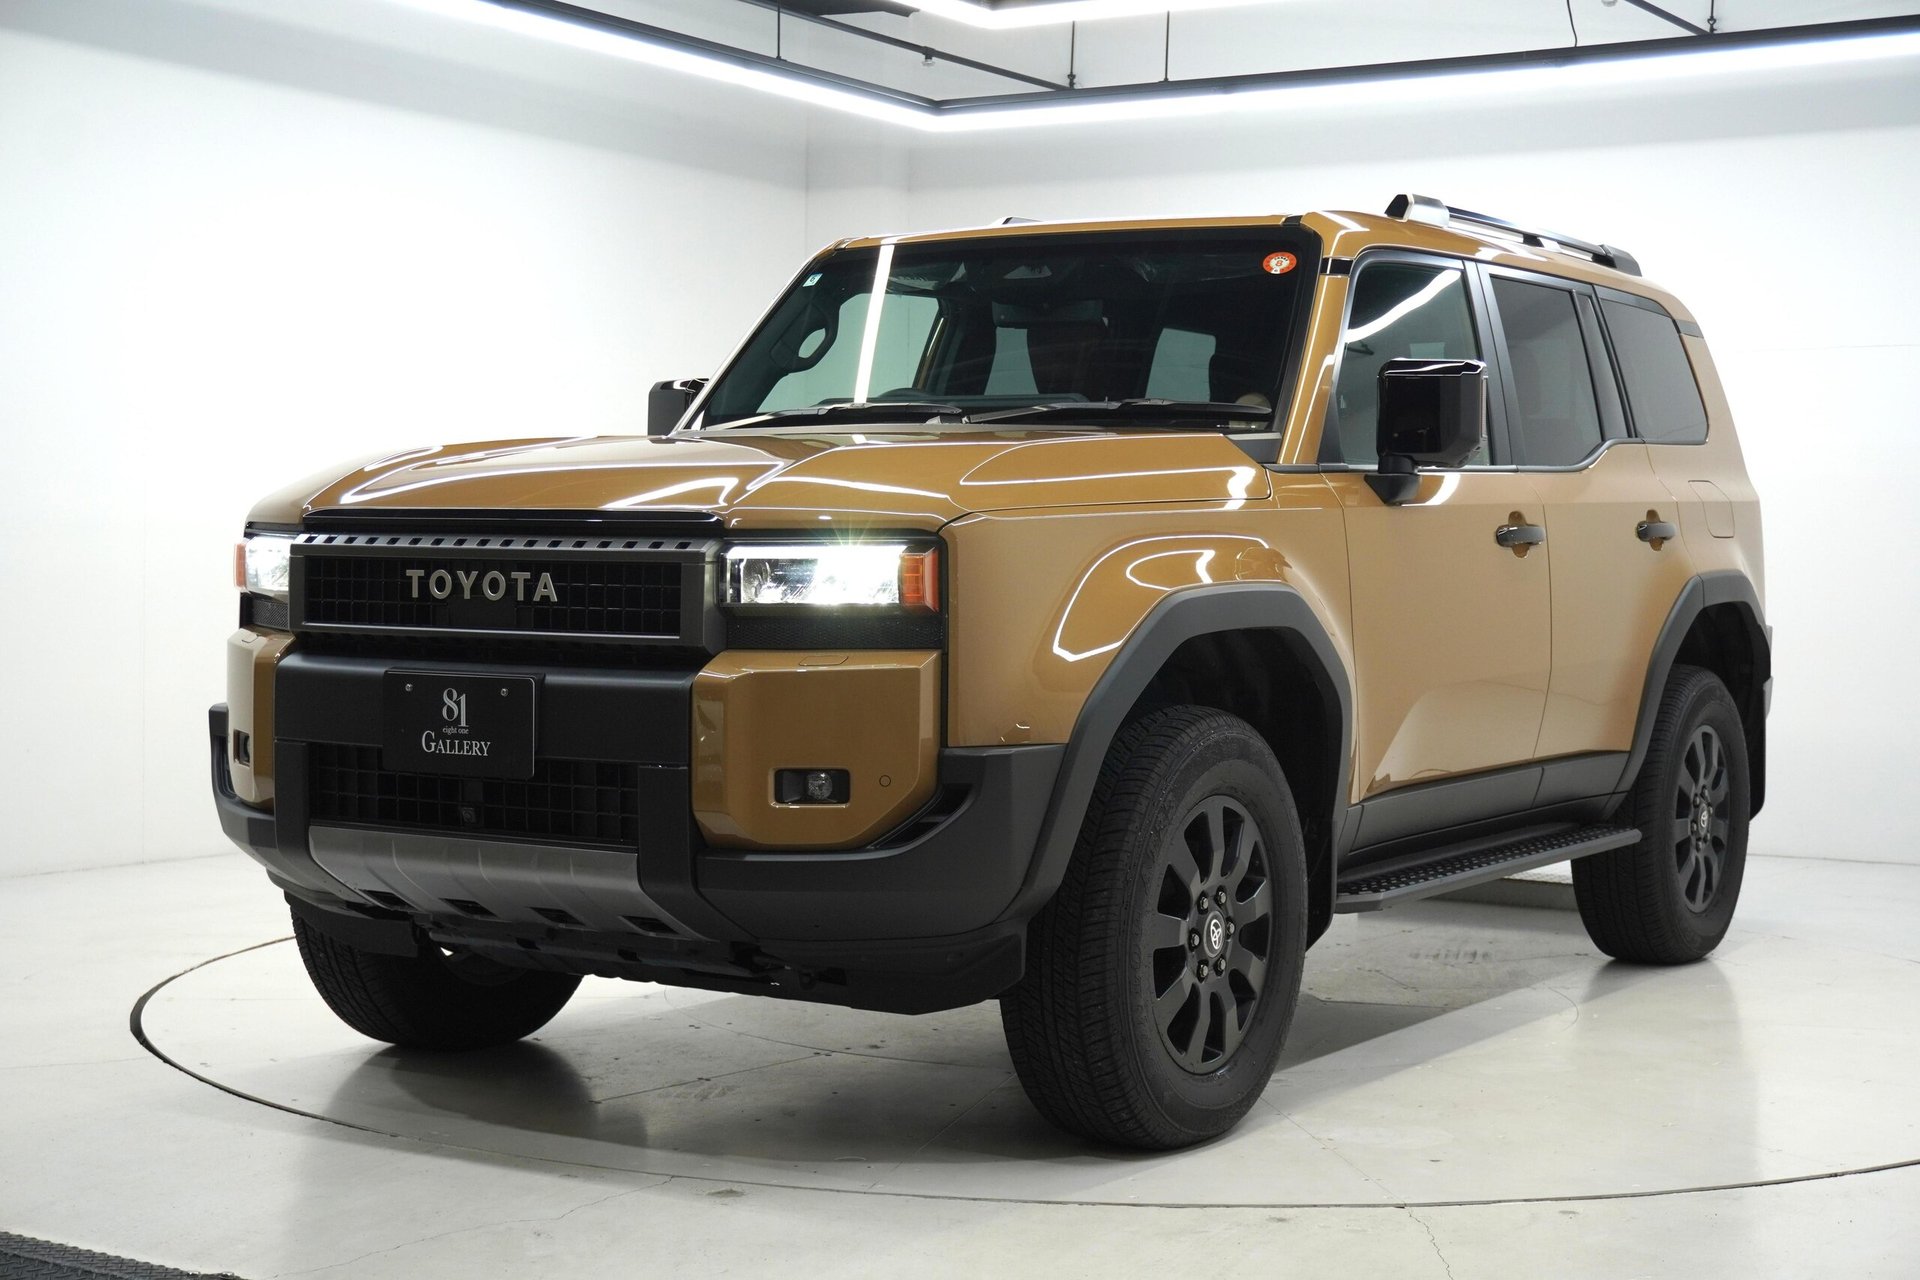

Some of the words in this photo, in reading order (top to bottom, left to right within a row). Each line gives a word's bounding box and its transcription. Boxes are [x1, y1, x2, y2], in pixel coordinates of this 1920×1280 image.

[405, 569, 558, 602] TOYOTA
[442, 687, 469, 727] 81
[421, 730, 491, 757] GALLERY
[442, 725, 457, 735] eight
[458, 727, 469, 735] one
